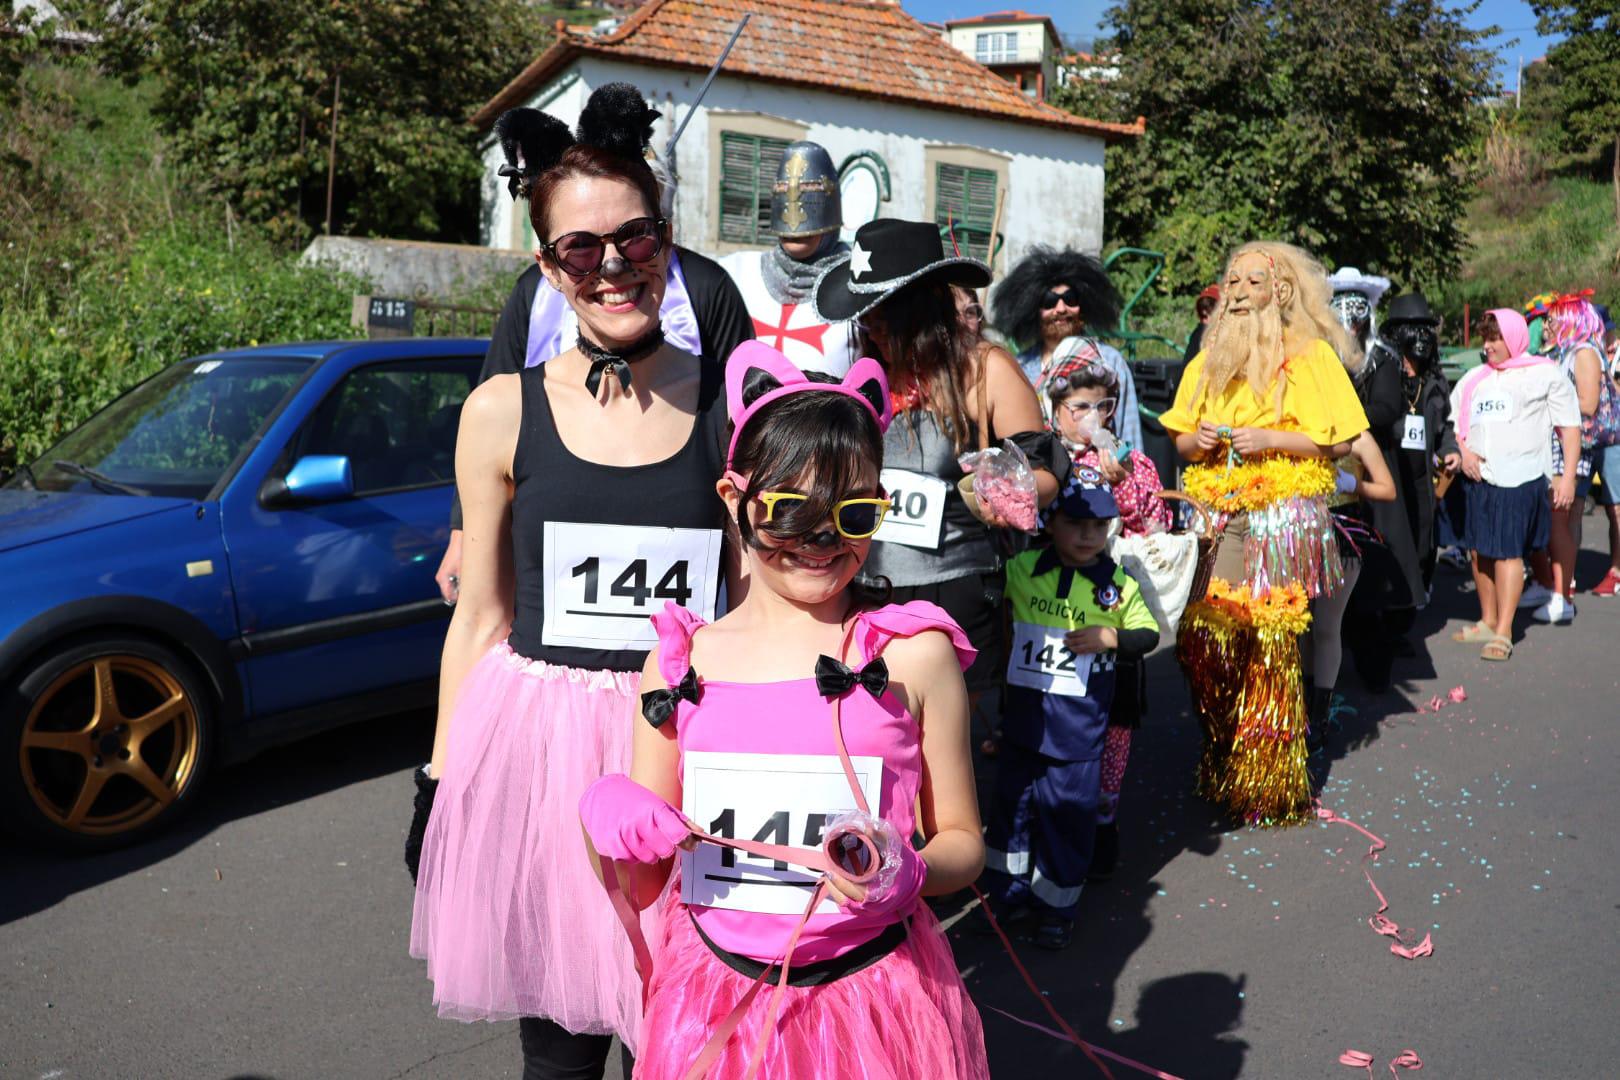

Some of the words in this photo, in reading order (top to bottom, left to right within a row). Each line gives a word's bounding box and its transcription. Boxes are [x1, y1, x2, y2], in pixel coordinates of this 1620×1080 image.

[1476, 400, 1506, 414] 356
[572, 557, 692, 607] 144
[1022, 640, 1077, 672] 142
